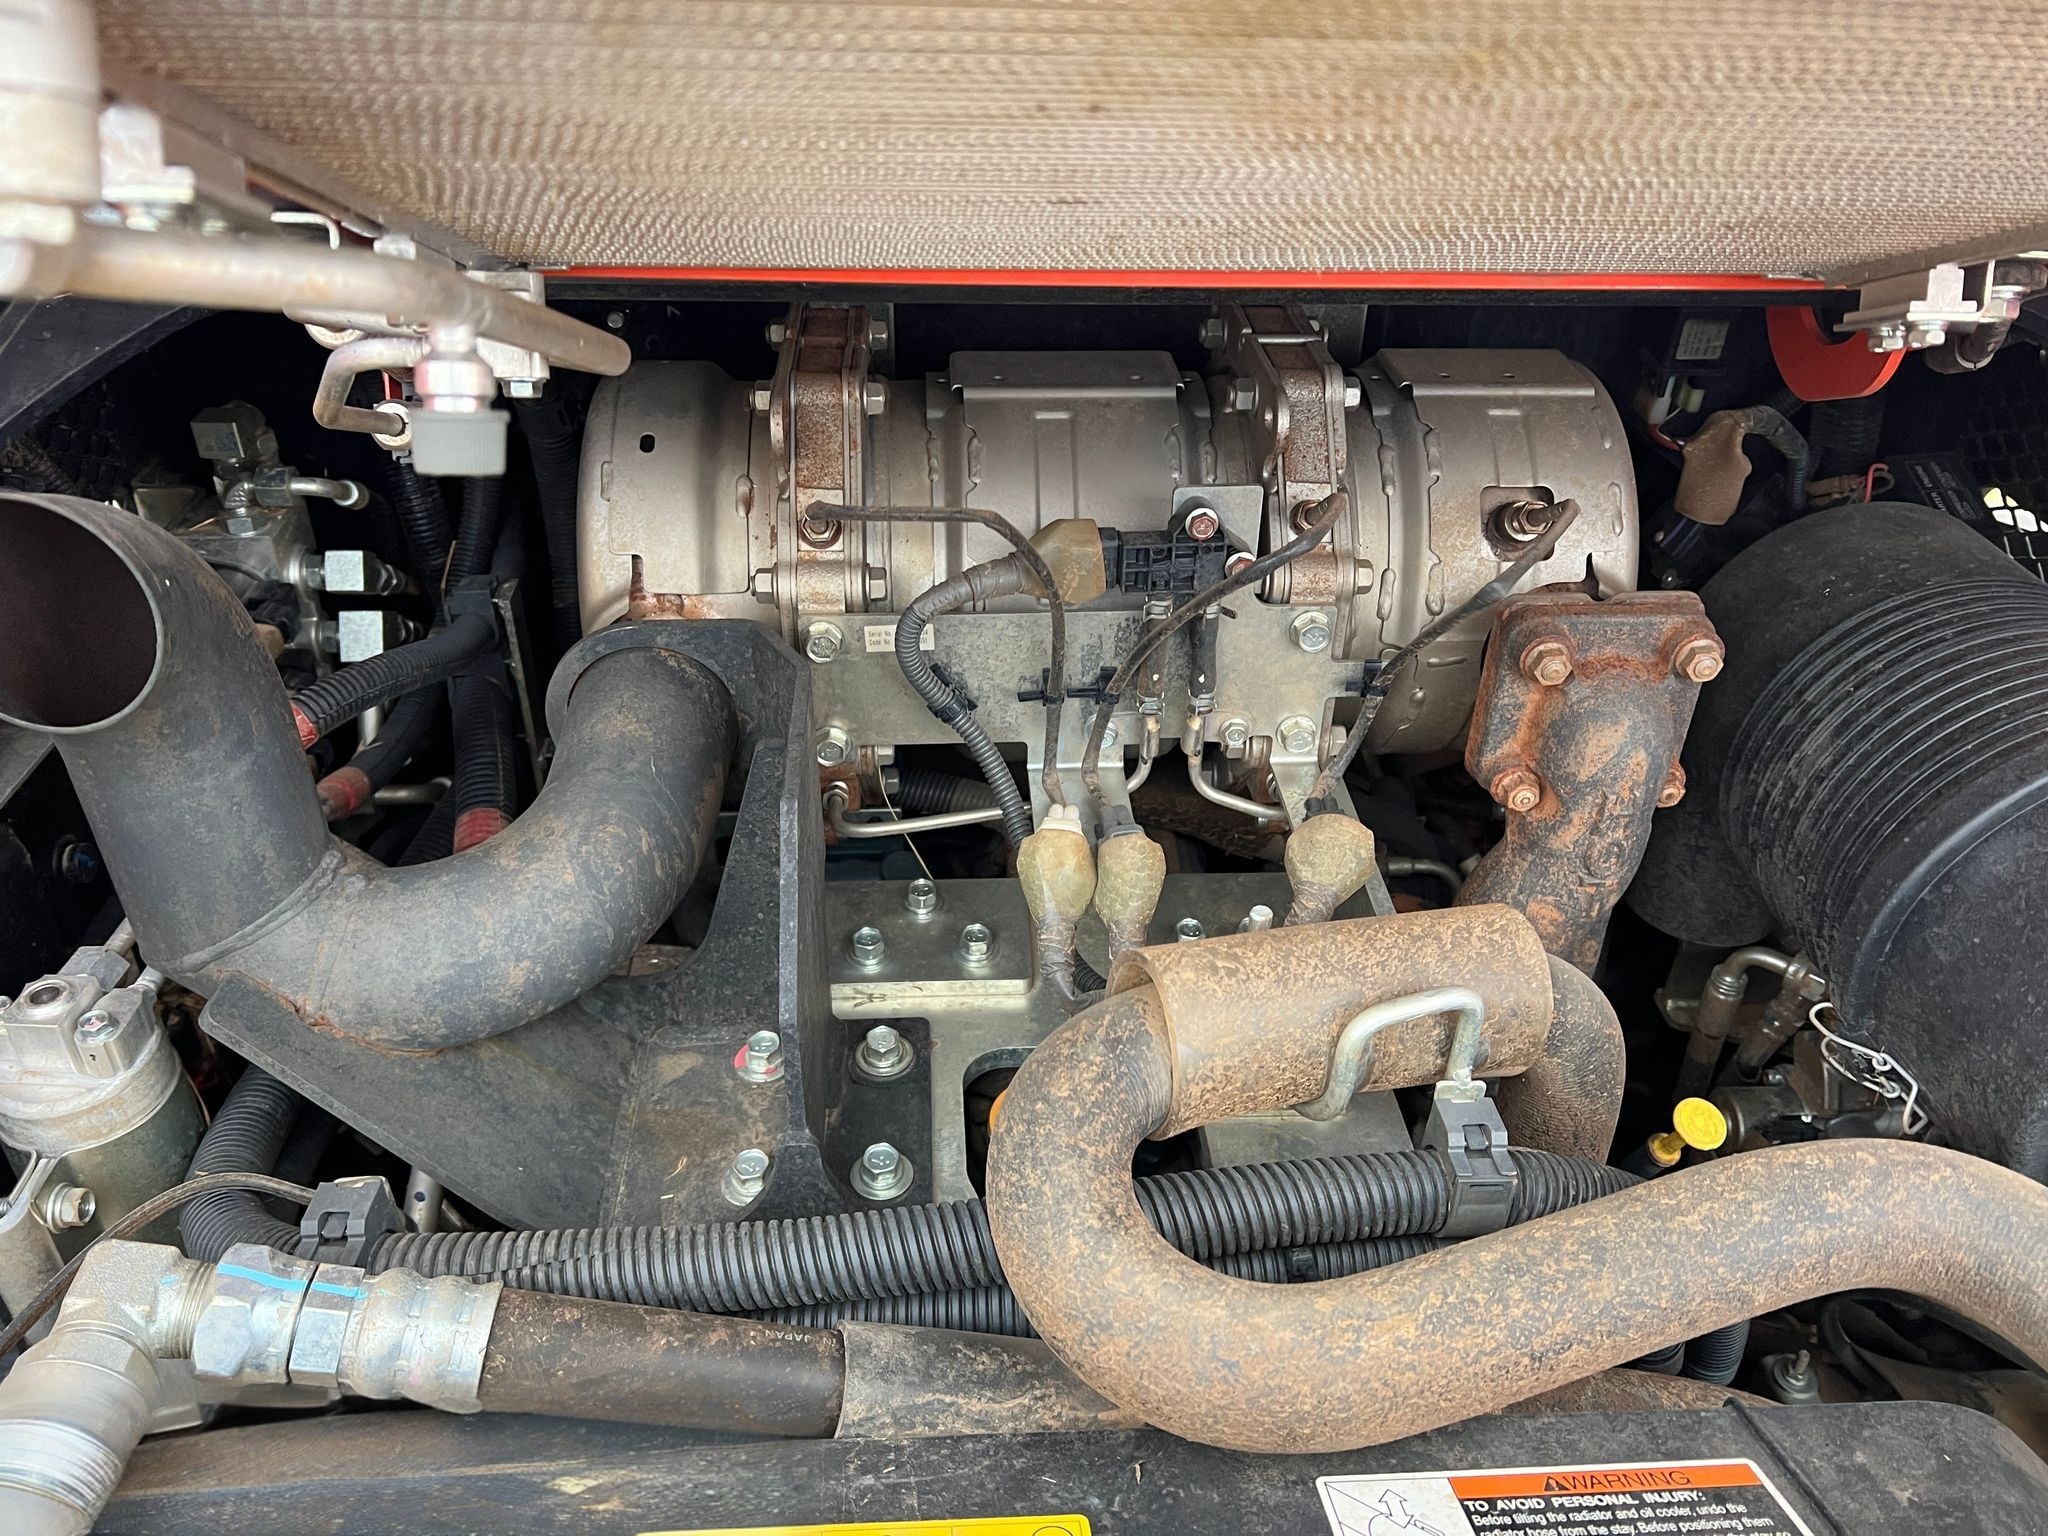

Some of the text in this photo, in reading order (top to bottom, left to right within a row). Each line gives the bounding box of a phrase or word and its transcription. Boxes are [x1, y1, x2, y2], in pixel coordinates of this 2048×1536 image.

[765, 1329, 811, 1343] JAPAN
[1562, 1470, 1693, 1490] WARNING
[1463, 1490, 1706, 1512] TO AVOID PERSONAL INJURY:
[1471, 1503, 1747, 1526] Before tilting the radiator and oil cooler, undo the
[1525, 1527, 1558, 1536] hose
[1558, 1525, 1588, 1536] from
[1587, 1524, 1609, 1536] the
[1609, 1523, 1638, 1536] stay.
[1636, 1520, 1678, 1533] Before
[1678, 1517, 1744, 1533] positioning
[1742, 1517, 1774, 1527] them
